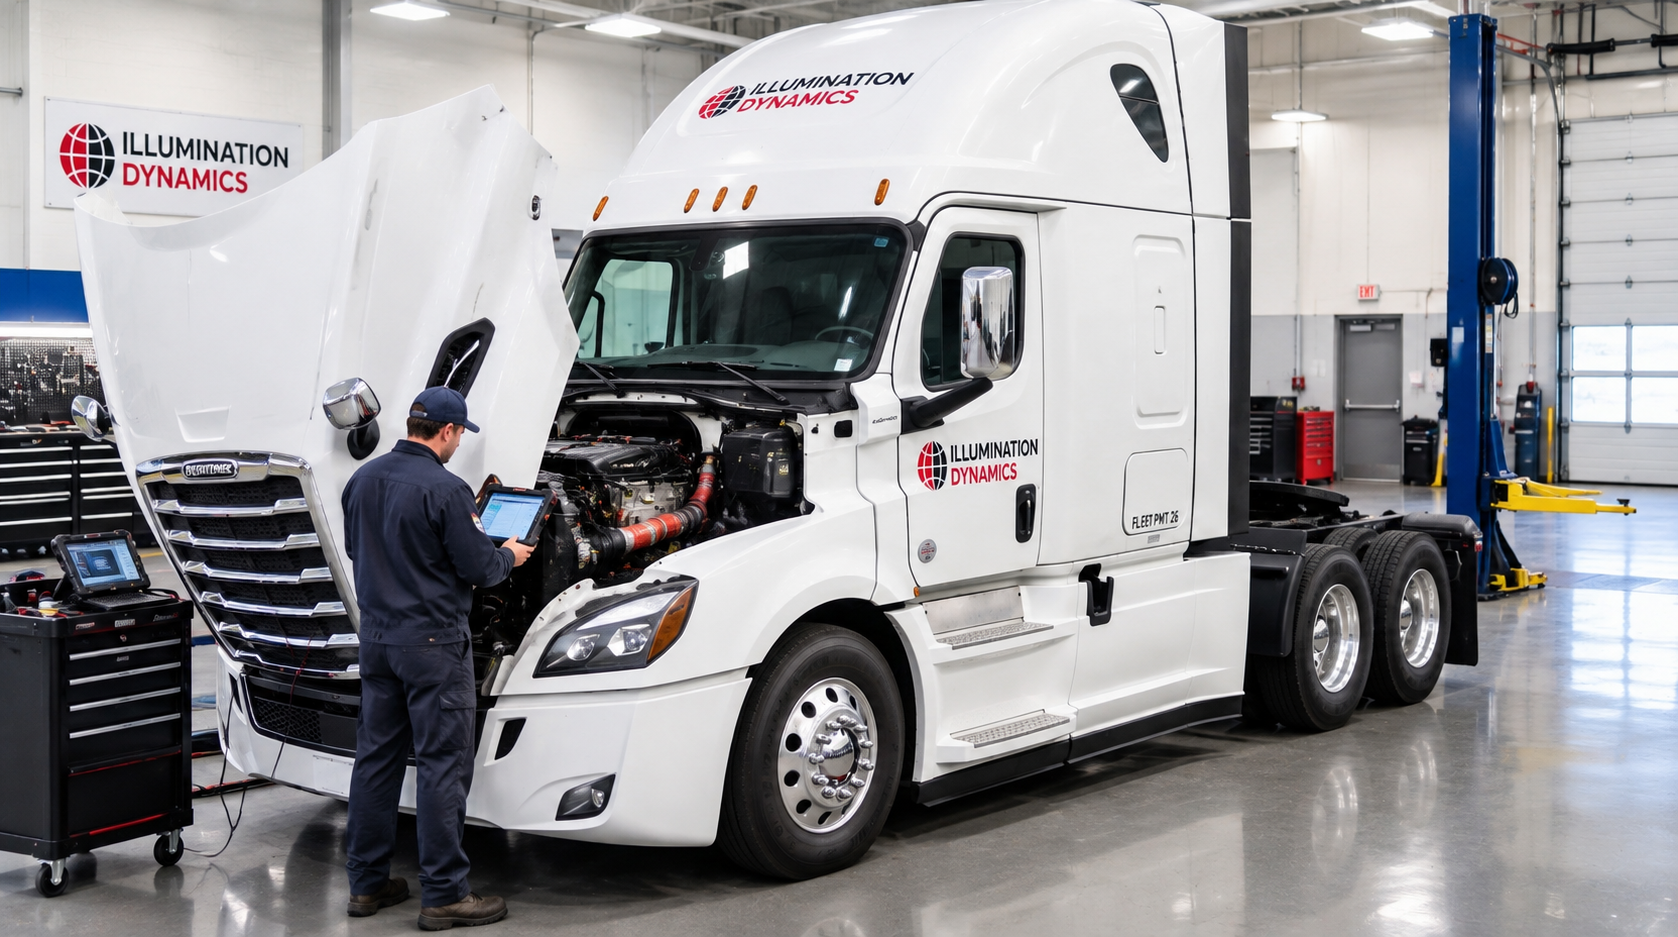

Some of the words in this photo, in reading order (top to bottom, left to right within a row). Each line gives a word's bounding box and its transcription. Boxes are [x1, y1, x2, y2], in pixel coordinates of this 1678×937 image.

[749, 72, 914, 96] ILLUMINATION
[737, 89, 859, 113] DYNAMICS
[122, 131, 289, 168] ILLUMINATION
[122, 162, 248, 193] DYNAMICS
[950, 438, 1039, 462] ILLUMINATION
[951, 462, 1017, 486] DYNAMICS
[1131, 514, 1153, 529] FLEET
[1153, 511, 1169, 526] PMT
